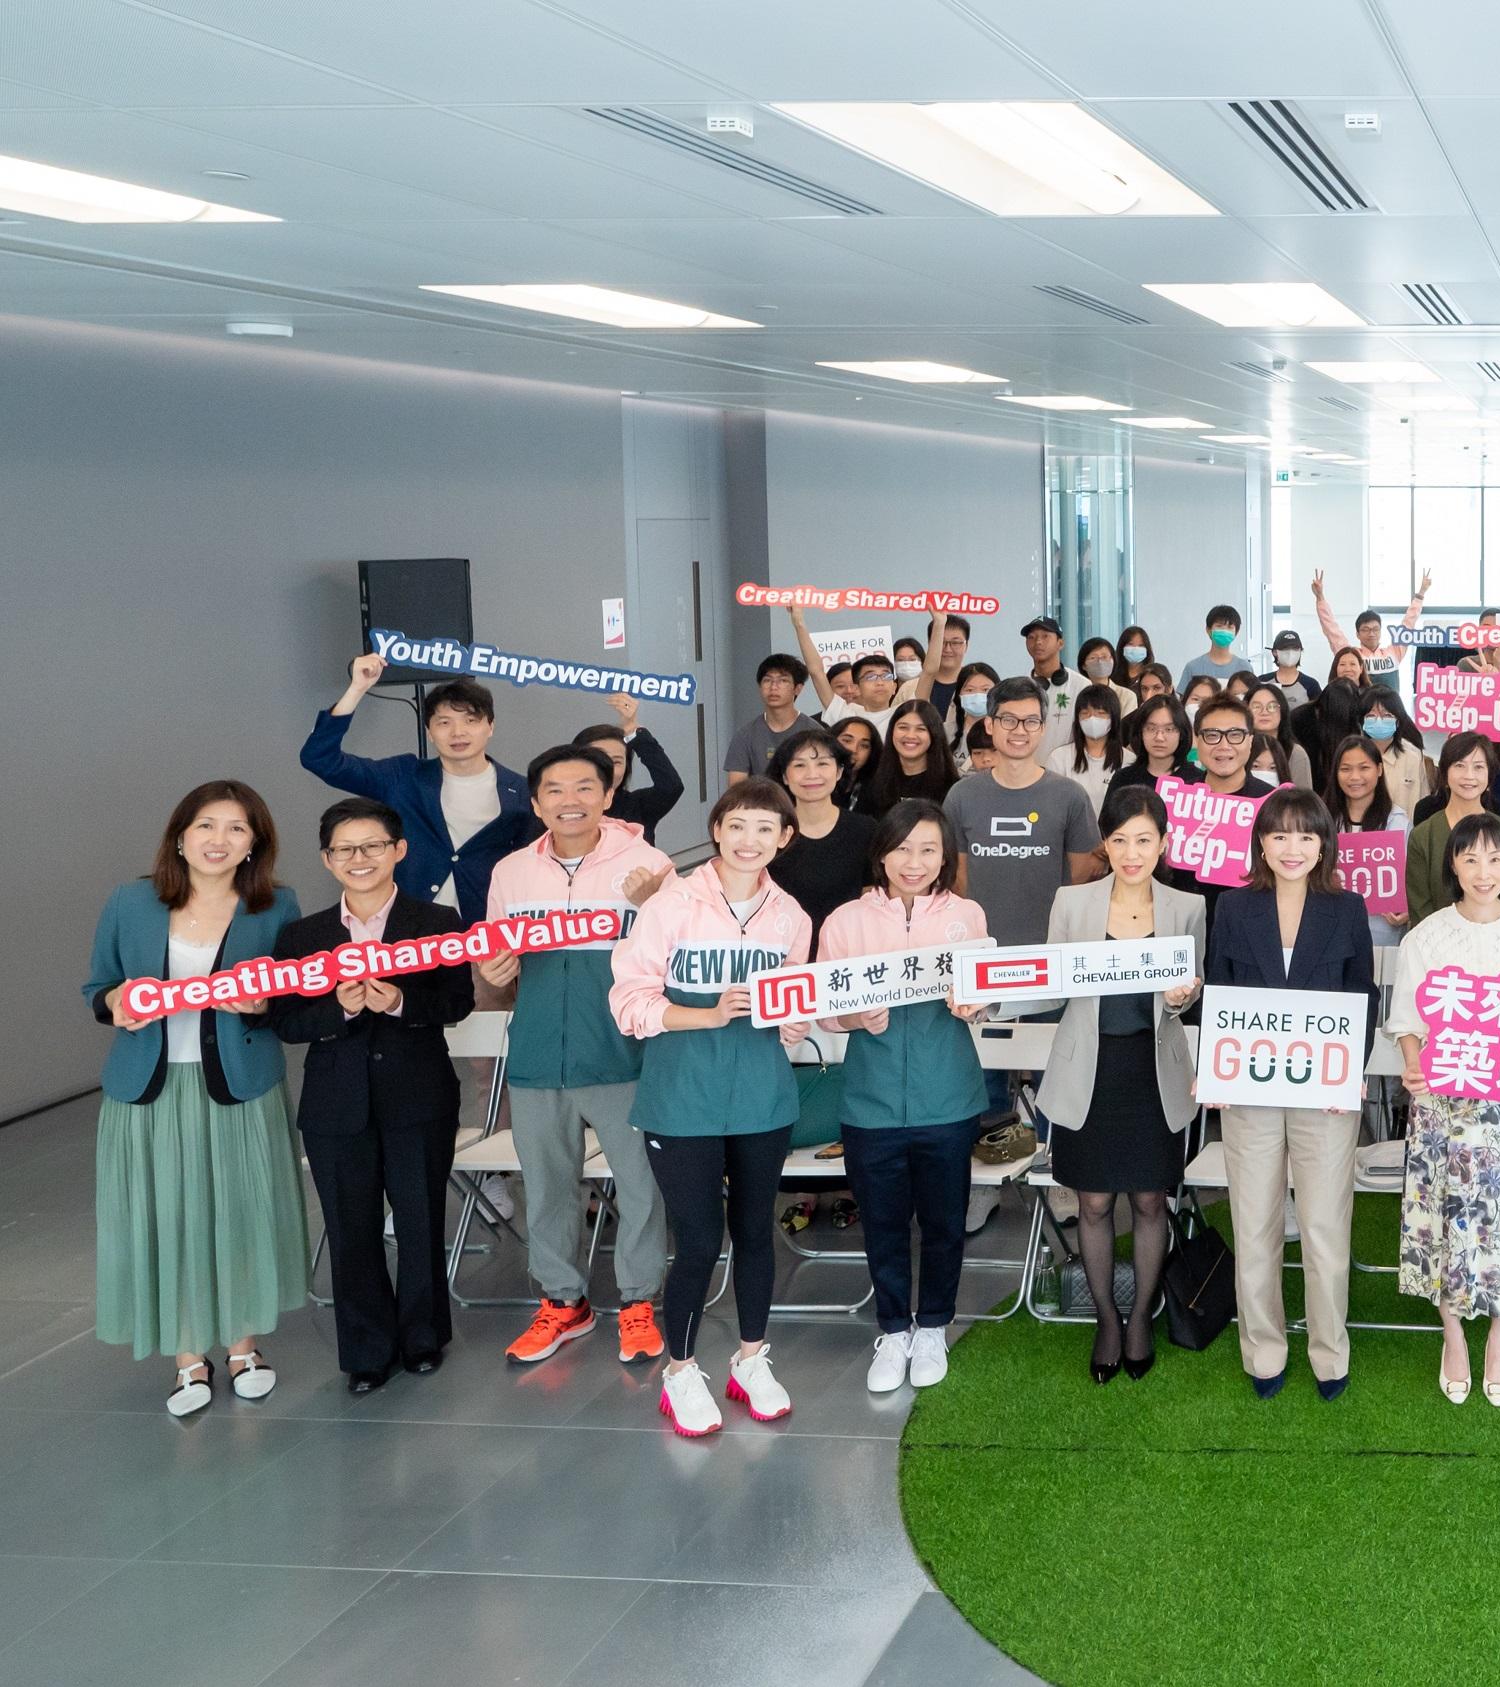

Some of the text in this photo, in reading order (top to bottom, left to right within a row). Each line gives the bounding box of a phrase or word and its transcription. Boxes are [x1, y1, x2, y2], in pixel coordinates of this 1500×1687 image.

[739, 585, 997, 613] Creating Shared Value
[817, 637, 886, 653] SHARE FOR
[1391, 627, 1444, 645] Youth
[374, 632, 692, 701] Youth Empowerment
[1420, 666, 1495, 697] Future
[1159, 780, 1255, 827] Future
[970, 843, 1051, 860] OneDegree
[1166, 822, 1252, 878] tep-
[1362, 846, 1396, 863] FOR
[128, 956, 330, 1014] Creating
[337, 927, 490, 978] Shared
[498, 912, 615, 951] Value
[671, 948, 788, 985] NEW WOR
[827, 951, 954, 993] 新世界發
[1072, 949, 1188, 971] 其士集團
[993, 970, 1031, 979] CHEVALIER
[1072, 967, 1188, 984] CHEVALIER GROUP
[829, 982, 953, 1011] New World Develo
[1216, 1010, 1350, 1036] SHARE FOR
[1212, 1037, 1350, 1087] GOOD
